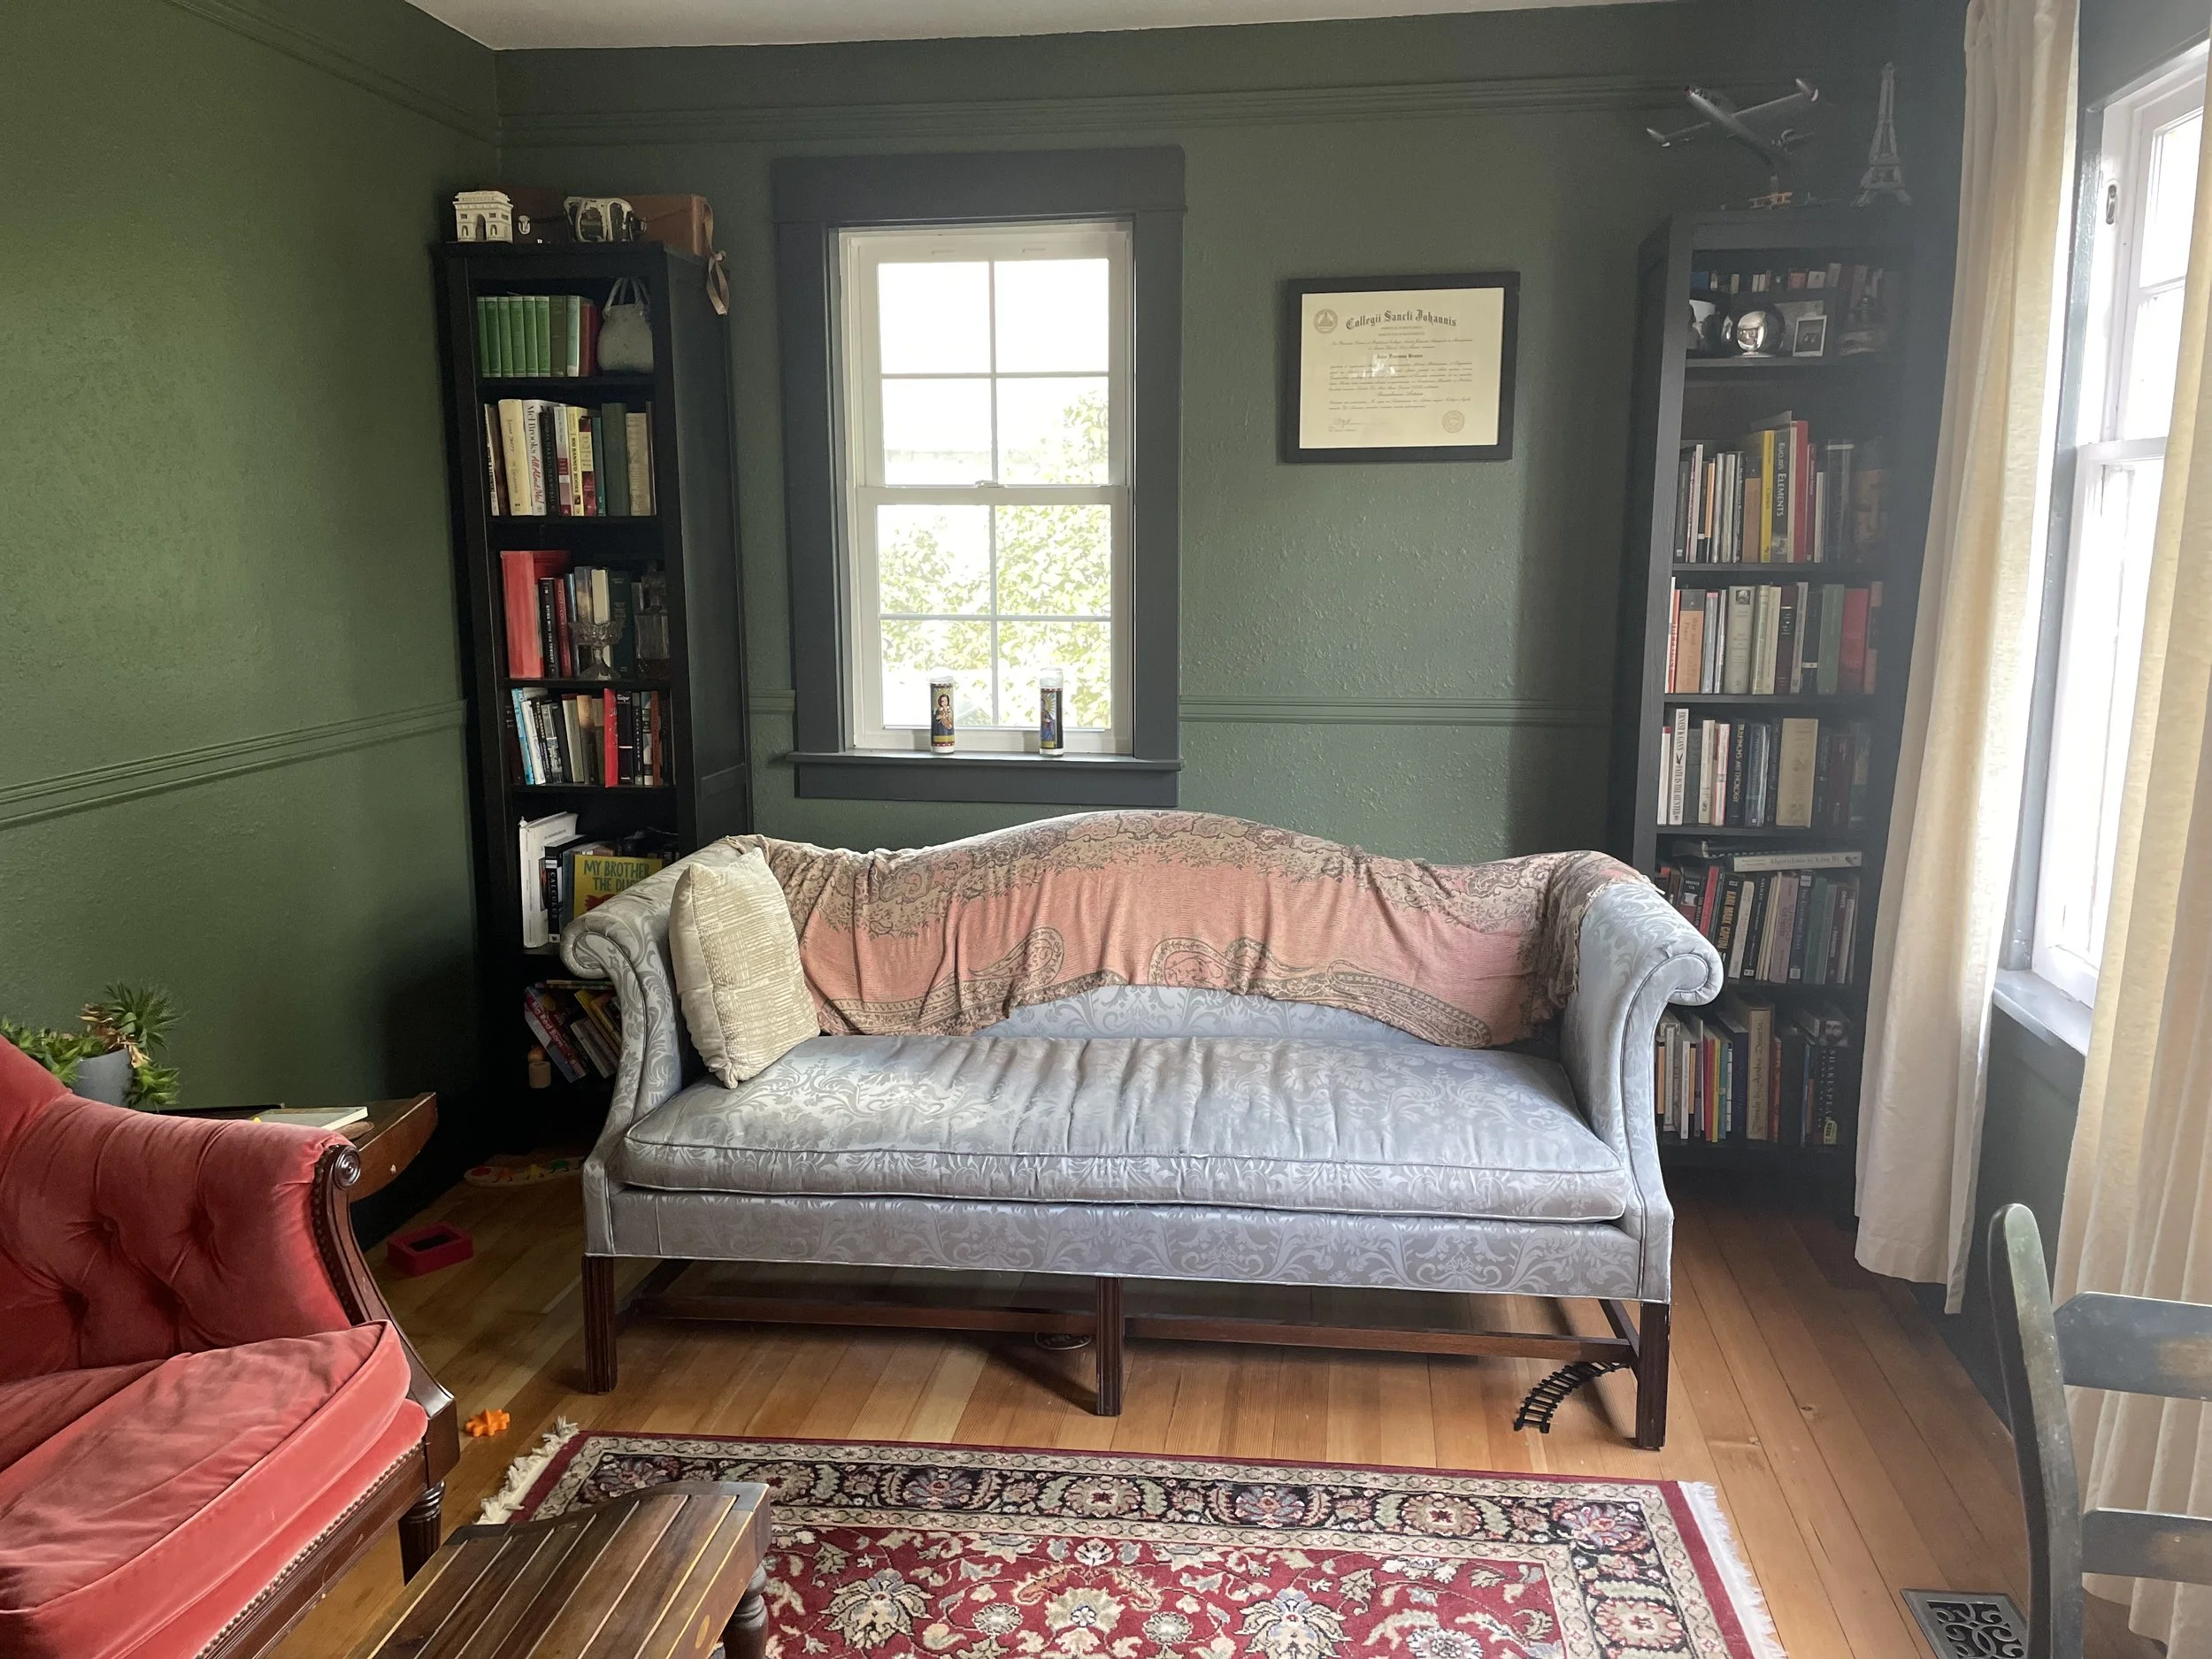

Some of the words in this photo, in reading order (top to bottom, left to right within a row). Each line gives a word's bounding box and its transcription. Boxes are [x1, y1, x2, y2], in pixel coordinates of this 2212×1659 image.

[1346, 312, 1381, 330] Collegii
[1384, 310, 1412, 323] Sancti
[1415, 309, 1457, 326] Johannis
[526, 405, 535, 421] Mel
[527, 423, 538, 454] Brooks
[1777, 472, 1787, 517] ELEMENTS
[1732, 761, 1742, 803] MYTHOLOGY
[584, 860, 603, 875] MY
[604, 860, 649, 879] BROTHER
[549, 872, 558, 919] CALCULUS
[593, 877, 611, 891] THE
[1725, 890, 1737, 906] KARL
[1722, 906, 1733, 925] MARX
[541, 1014, 553, 1029] Red
[549, 1029, 565, 1048] Barn
[1824, 1049, 1836, 1124] SHAKESPEA
